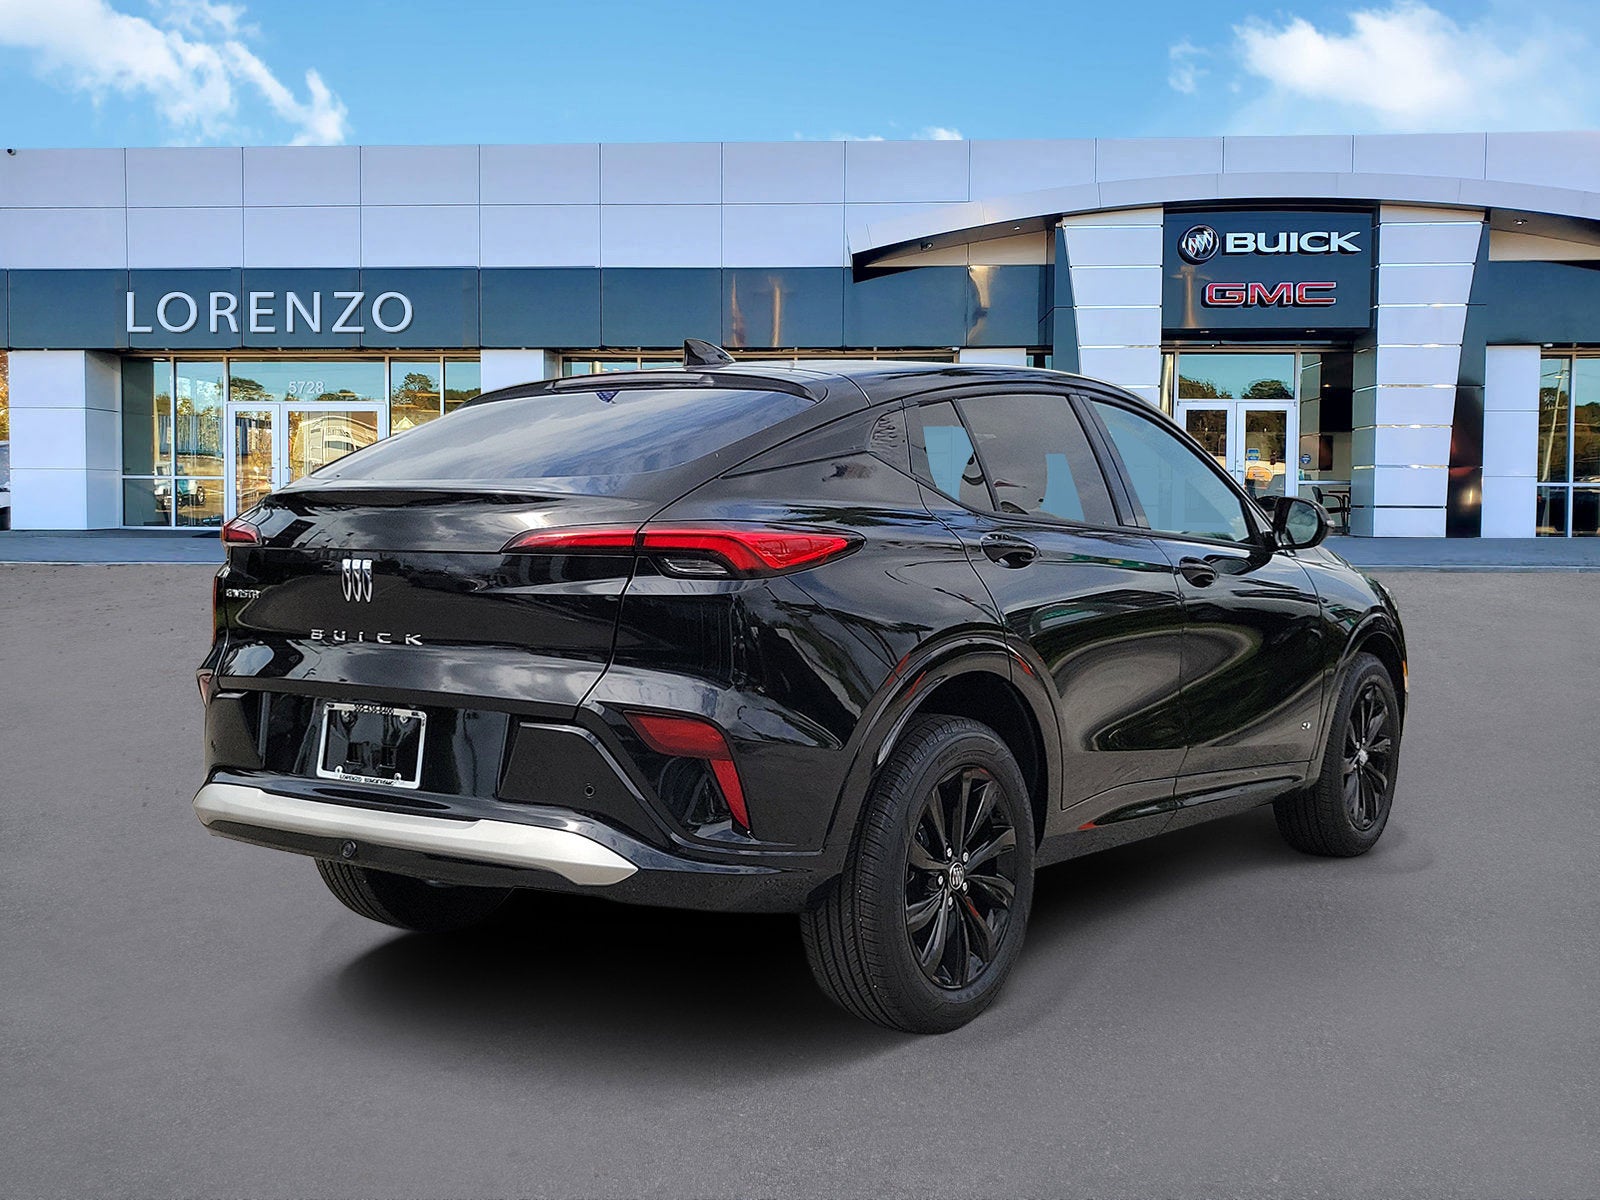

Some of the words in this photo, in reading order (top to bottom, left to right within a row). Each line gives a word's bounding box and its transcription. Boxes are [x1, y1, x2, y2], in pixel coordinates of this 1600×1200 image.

[1225, 231, 1362, 254] BUICK
[1205, 281, 1337, 305] GMC
[126, 291, 413, 334] LORENZO
[288, 380, 326, 395] 5728
[310, 628, 424, 647] BUICK
